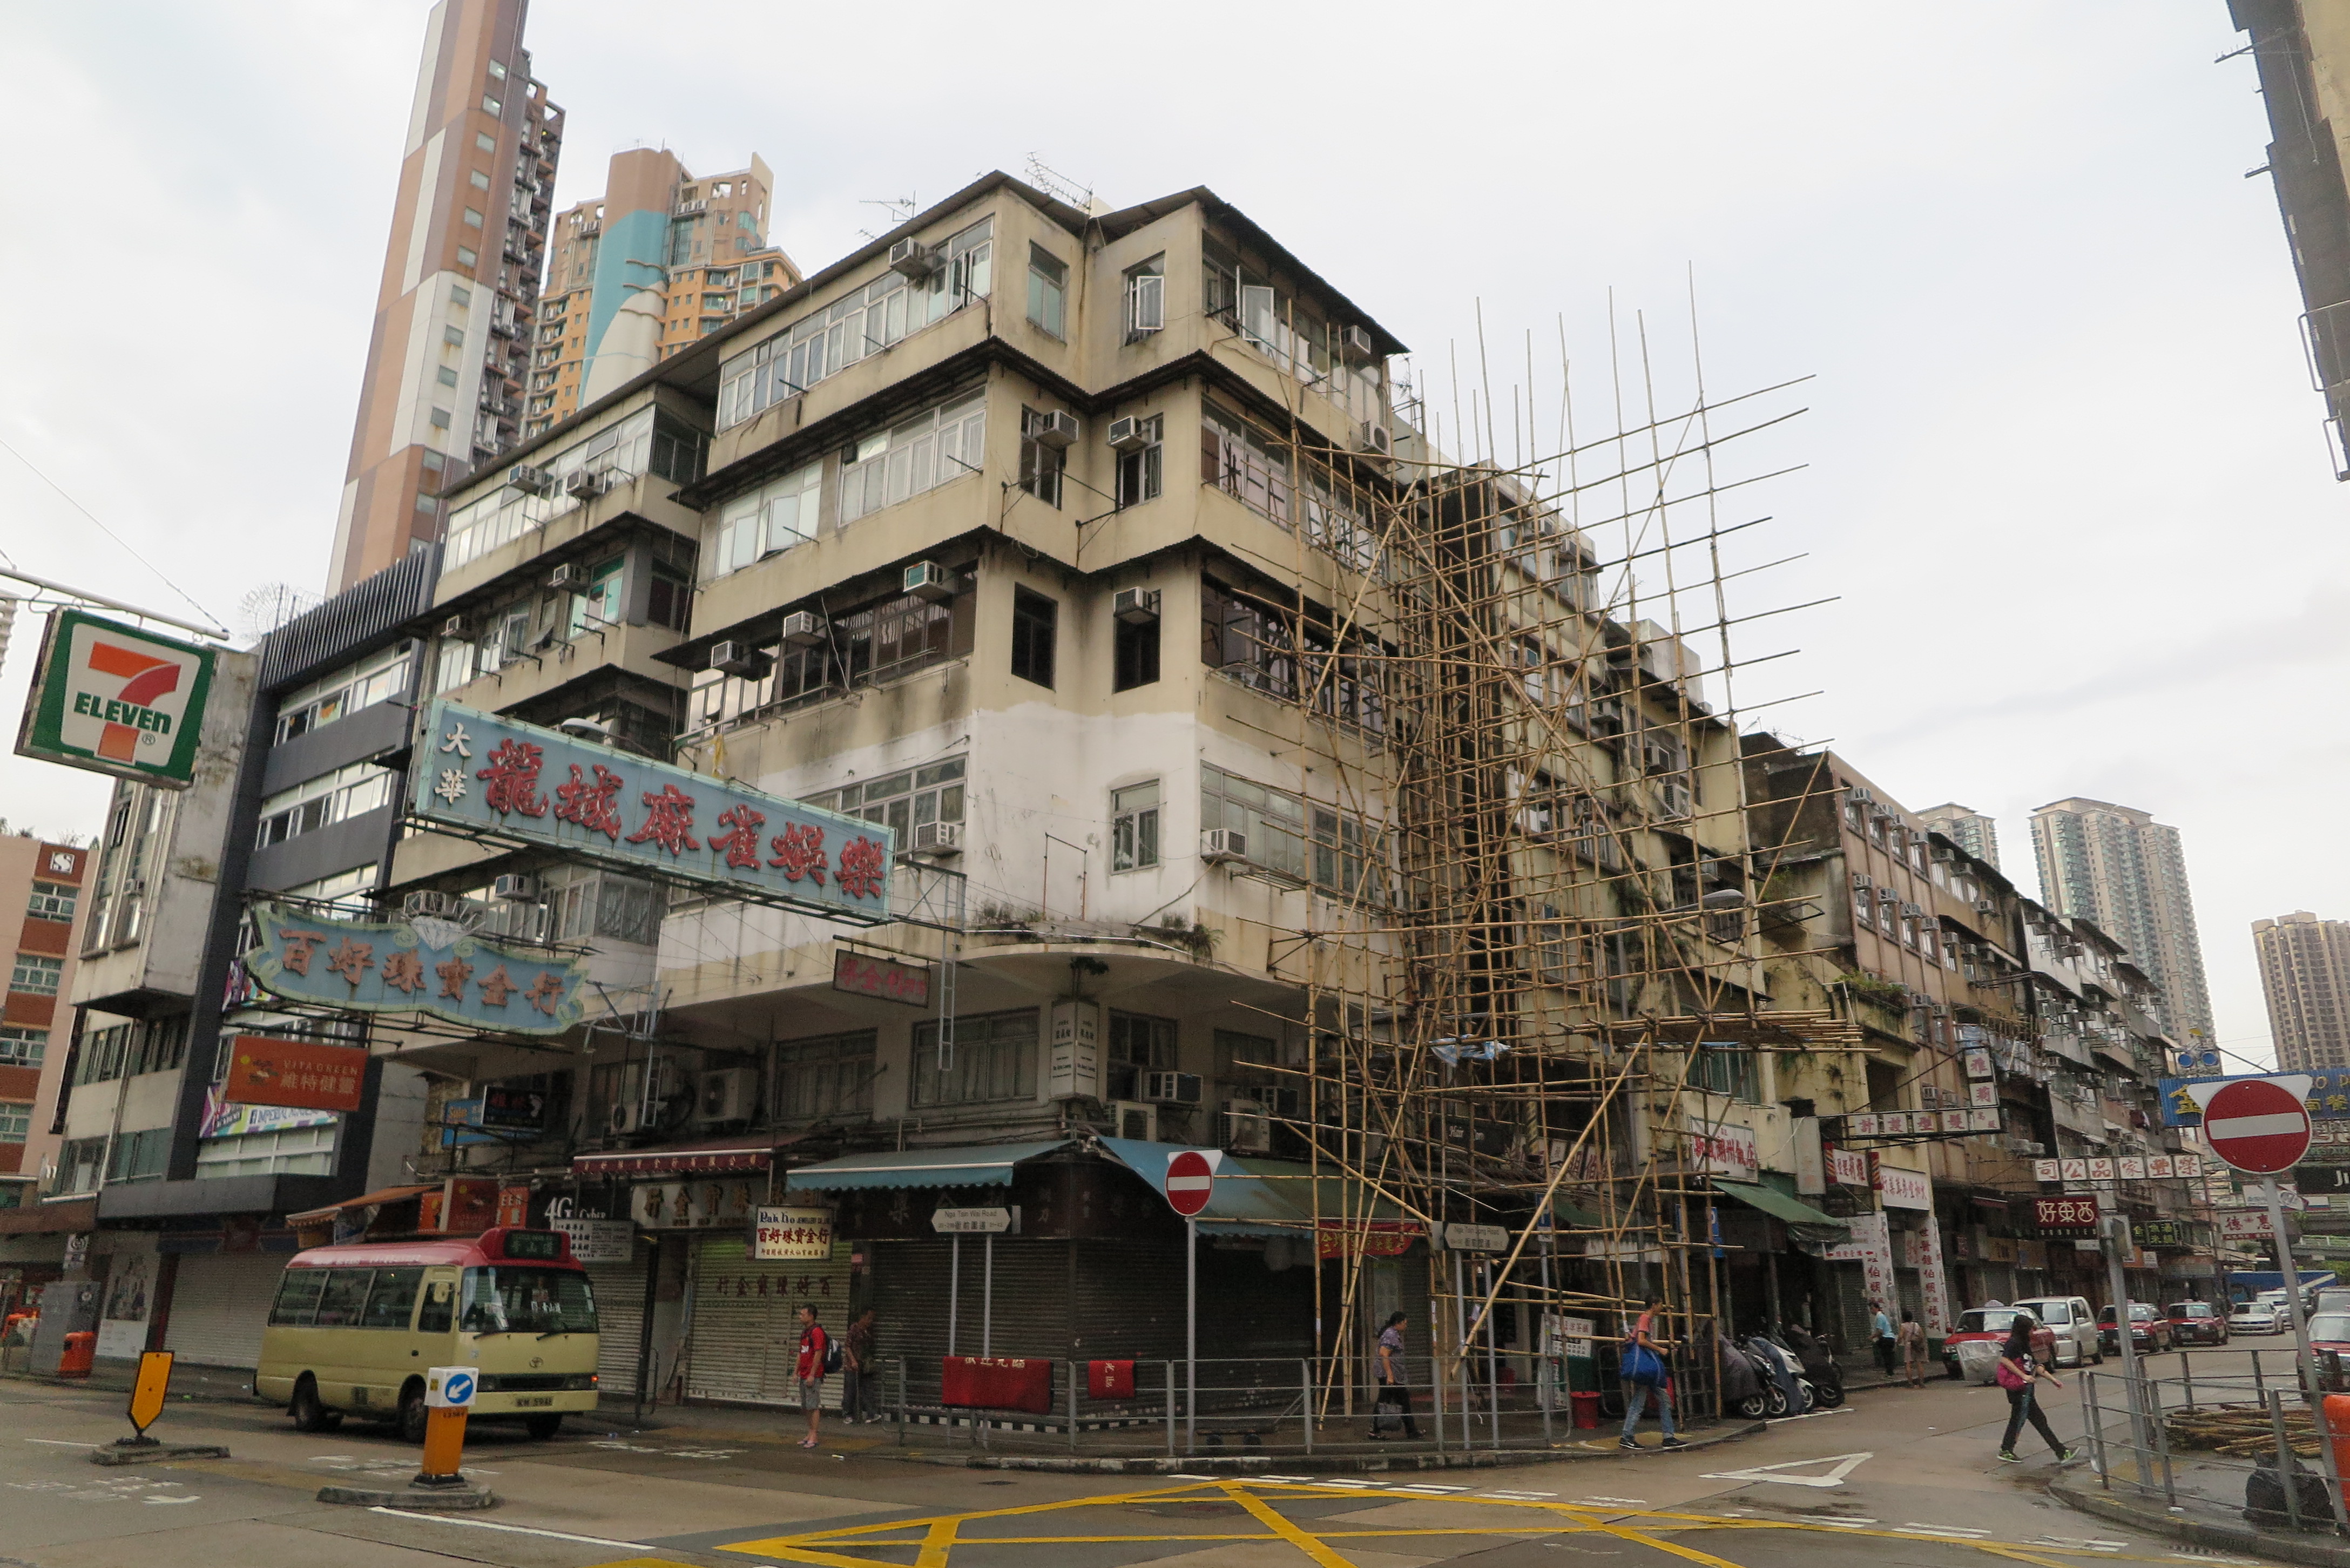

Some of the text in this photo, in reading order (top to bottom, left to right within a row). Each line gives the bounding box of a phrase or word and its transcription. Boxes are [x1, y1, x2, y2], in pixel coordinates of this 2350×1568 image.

[89, 641, 181, 762] 7
[435, 722, 472, 805] 大華
[476, 738, 884, 899] 龍城麻雀娛樂
[279, 929, 565, 1015] 百好珠寶金行
[757, 1227, 830, 1245] 百好珠寶金行
[2036, 1200, 2095, 1222] 好東西
